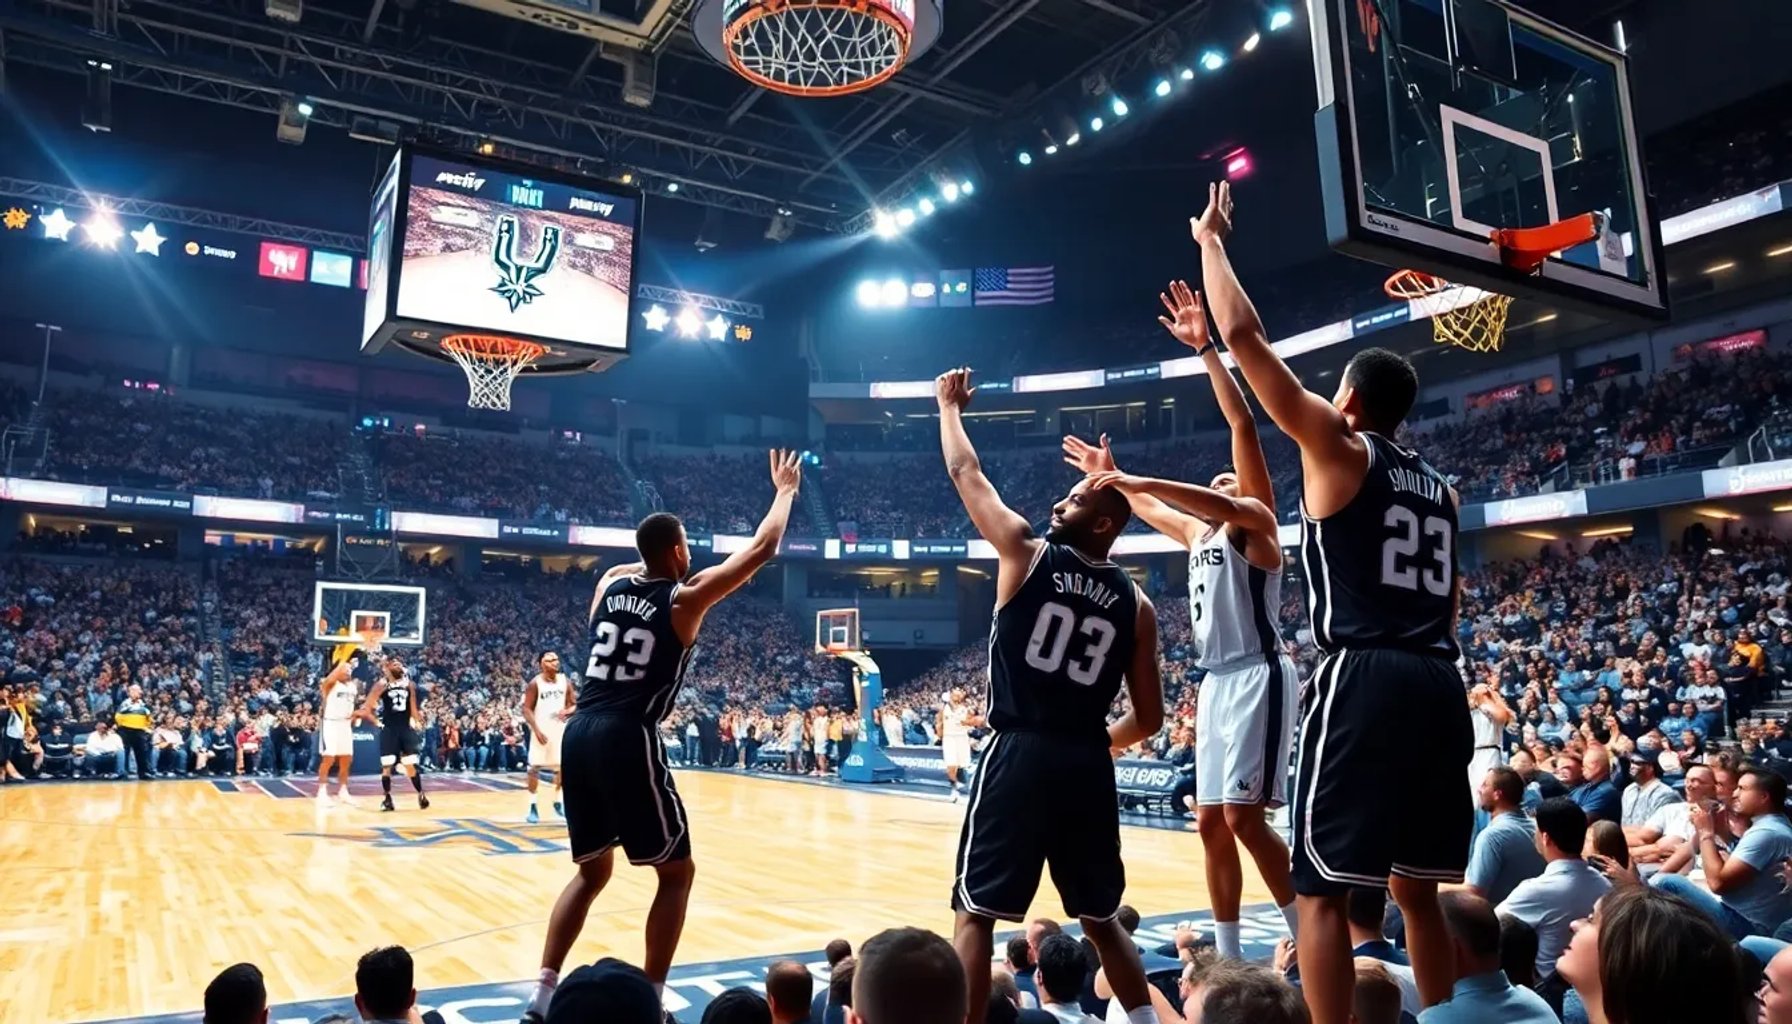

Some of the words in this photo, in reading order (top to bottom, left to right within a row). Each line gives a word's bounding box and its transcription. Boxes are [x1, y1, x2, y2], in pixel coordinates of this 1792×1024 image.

[1381, 504, 1452, 597] 23
[586, 621, 656, 681] 23
[1025, 601, 1116, 686] 03
